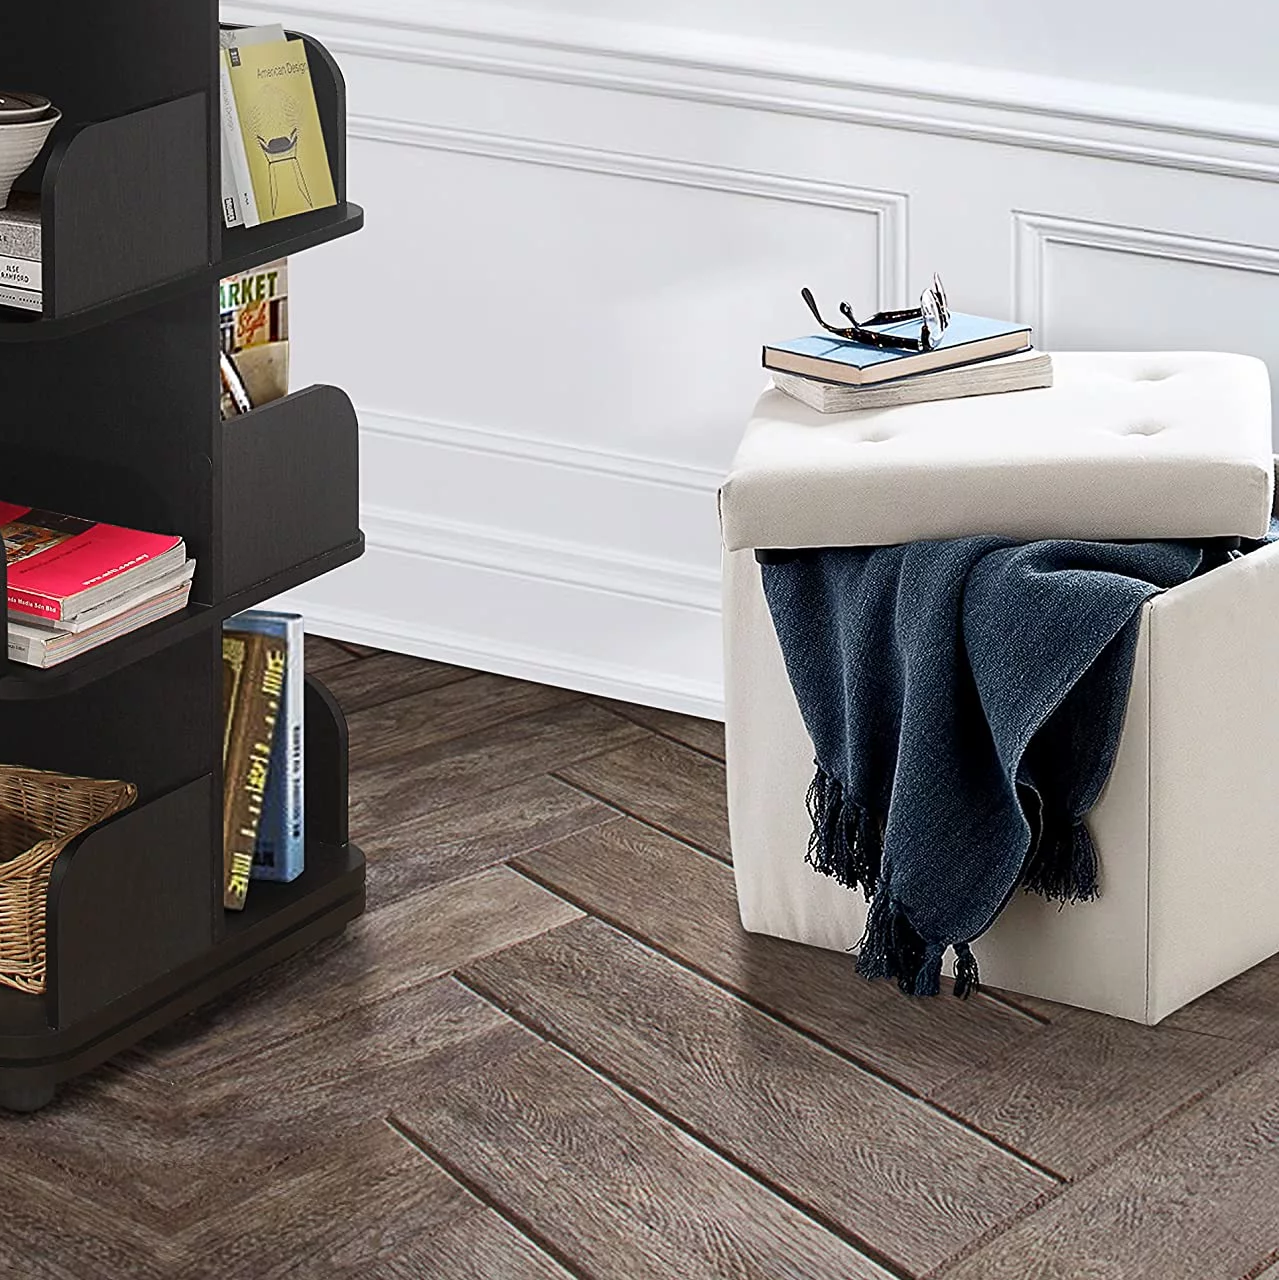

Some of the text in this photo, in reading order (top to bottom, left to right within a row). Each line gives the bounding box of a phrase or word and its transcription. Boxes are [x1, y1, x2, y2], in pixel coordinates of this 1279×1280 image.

[257, 62, 307, 79] American Design
[6, 264, 20, 273] ILSE
[18, 598, 33, 608] Media
[46, 604, 56, 613] Bhd
